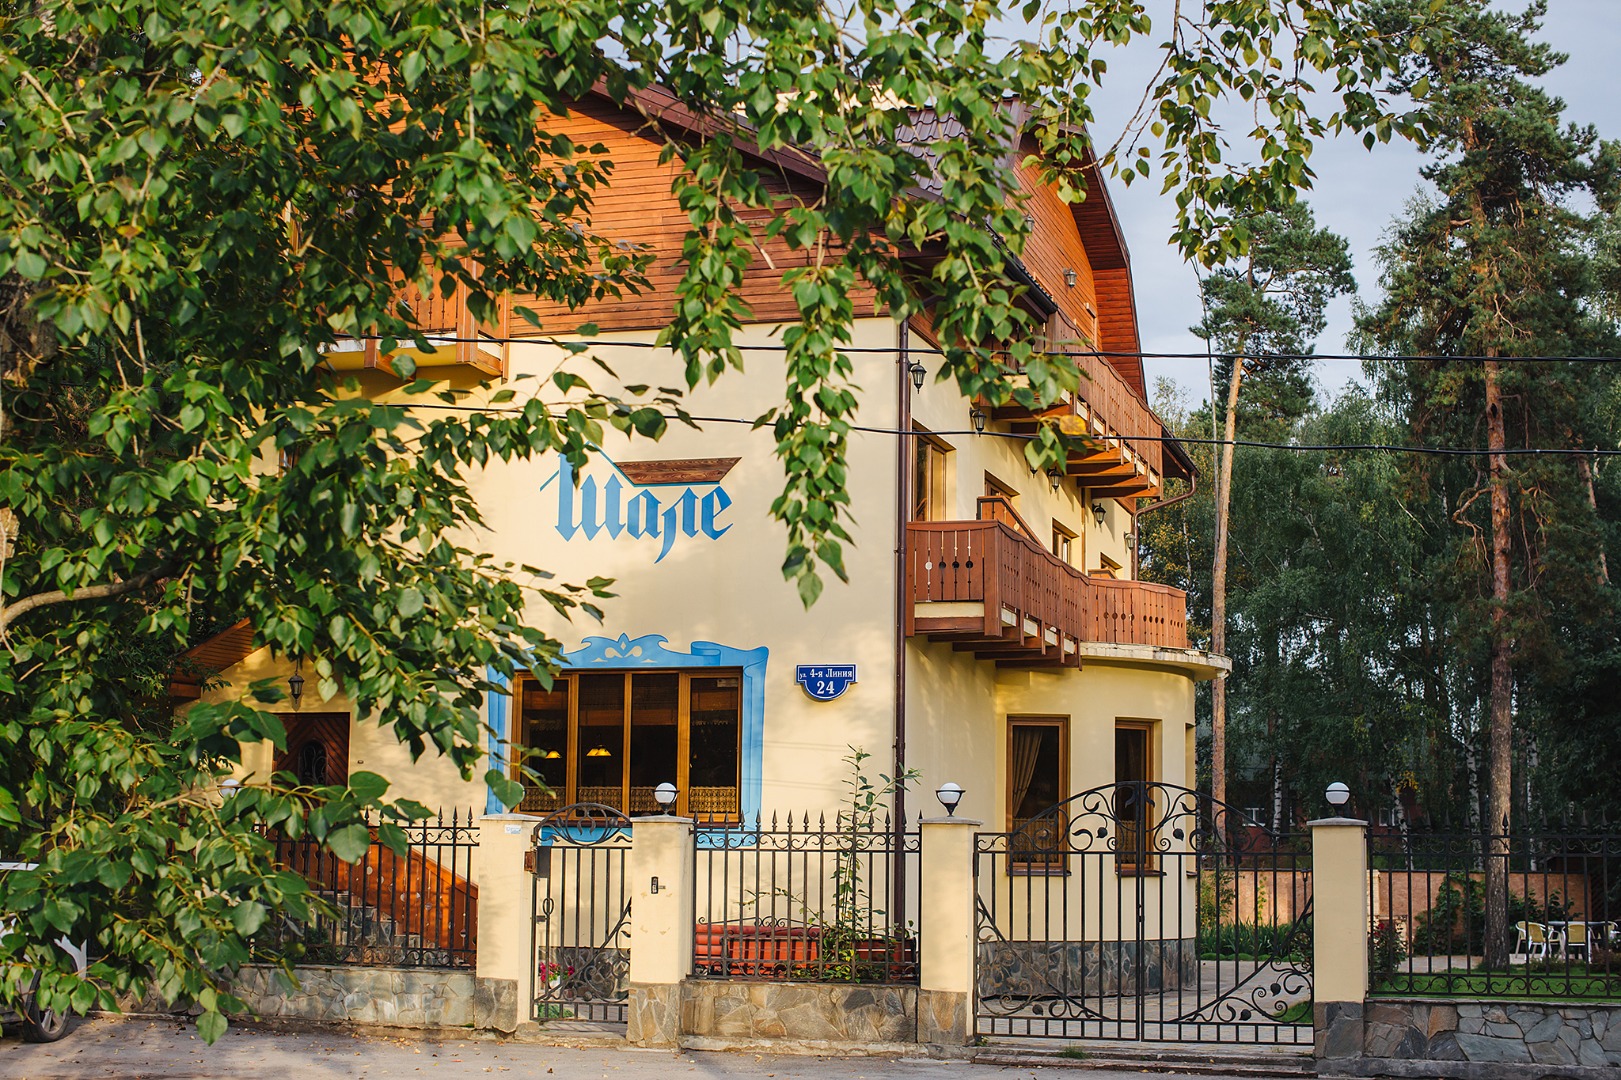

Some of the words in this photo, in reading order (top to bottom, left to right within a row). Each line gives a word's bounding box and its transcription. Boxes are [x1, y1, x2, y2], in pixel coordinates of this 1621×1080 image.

[540, 451, 734, 564] Шале
[809, 668, 823, 678] 4-я
[825, 668, 852, 678] Линия
[816, 680, 835, 694] 24
